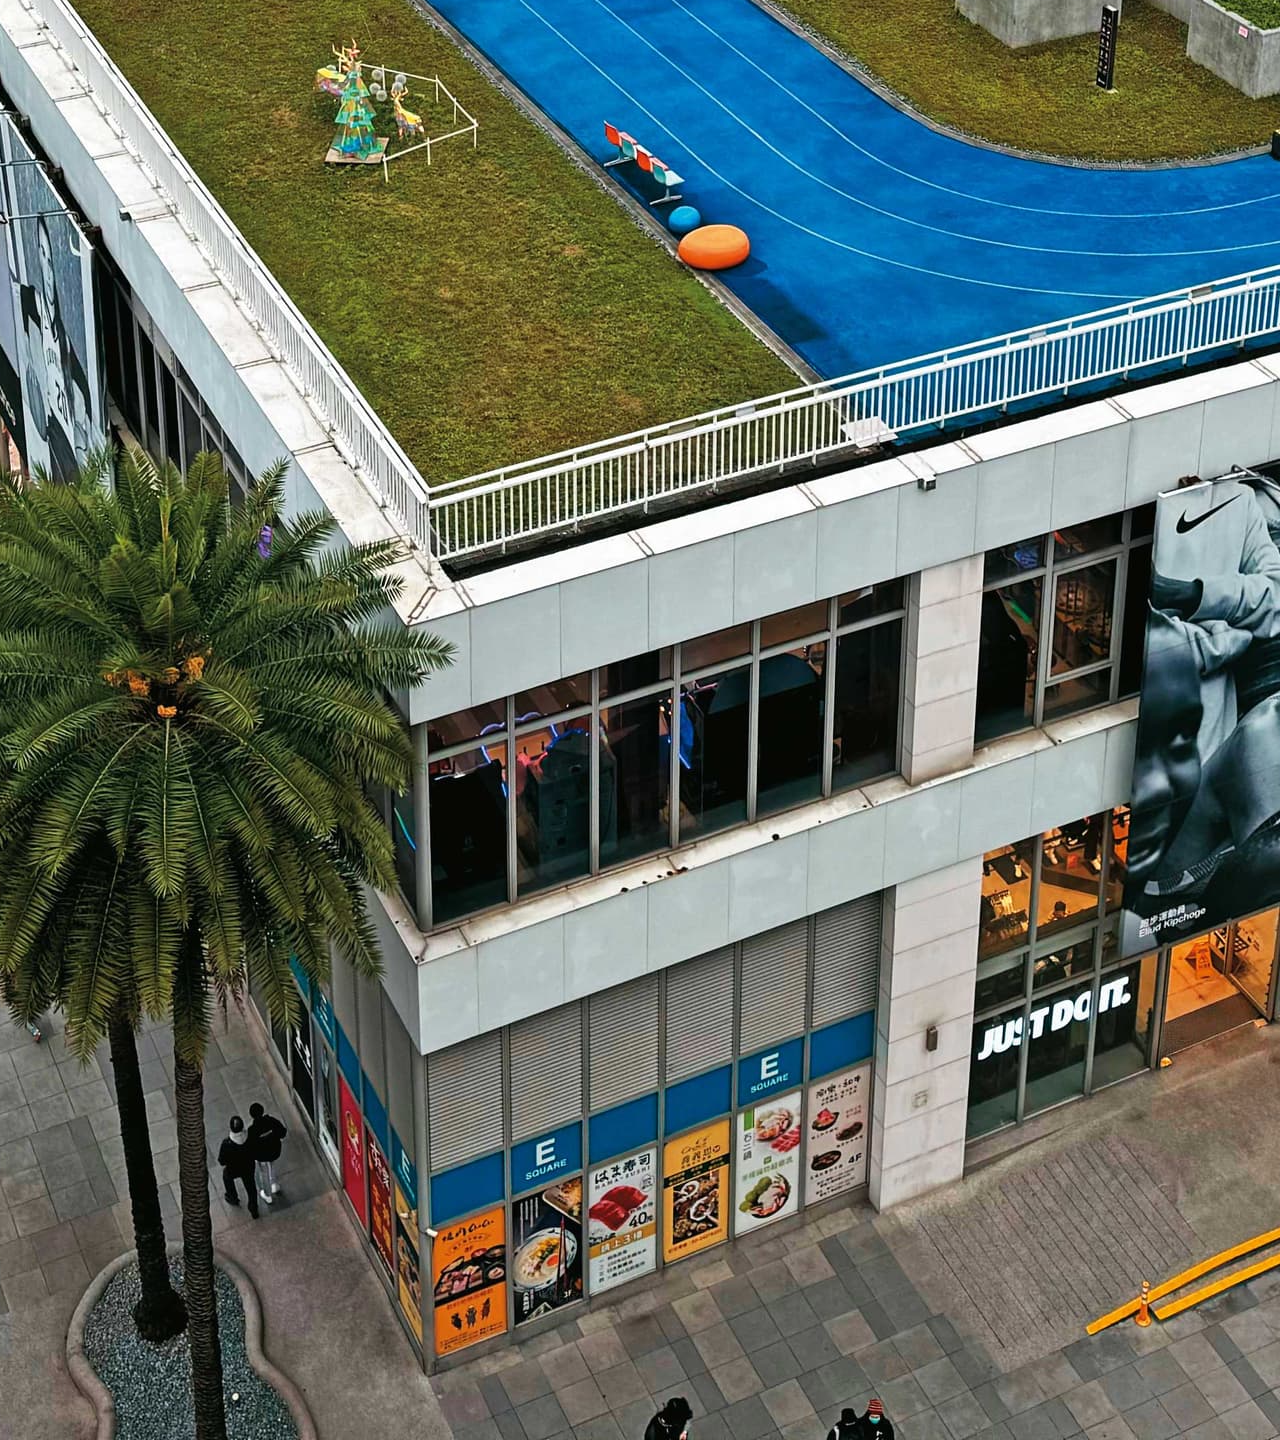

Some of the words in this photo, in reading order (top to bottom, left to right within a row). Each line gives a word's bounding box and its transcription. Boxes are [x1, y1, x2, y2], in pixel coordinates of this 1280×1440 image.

[1138, 923, 1162, 938] Eliud
[1163, 906, 1207, 930] Kipchoge
[1139, 904, 1186, 930] 跑步運動員
[977, 1006, 1050, 1061] JUST
[1050, 990, 1093, 1032] DO
[759, 1052, 780, 1081] E
[749, 1072, 789, 1094] SQUARE
[535, 1137, 556, 1167] E
[743, 1131, 753, 1161] 石二鍋
[847, 1152, 862, 1165] 4F
[525, 1158, 568, 1181] SQUARE
[594, 1153, 651, 1185] はま寿司
